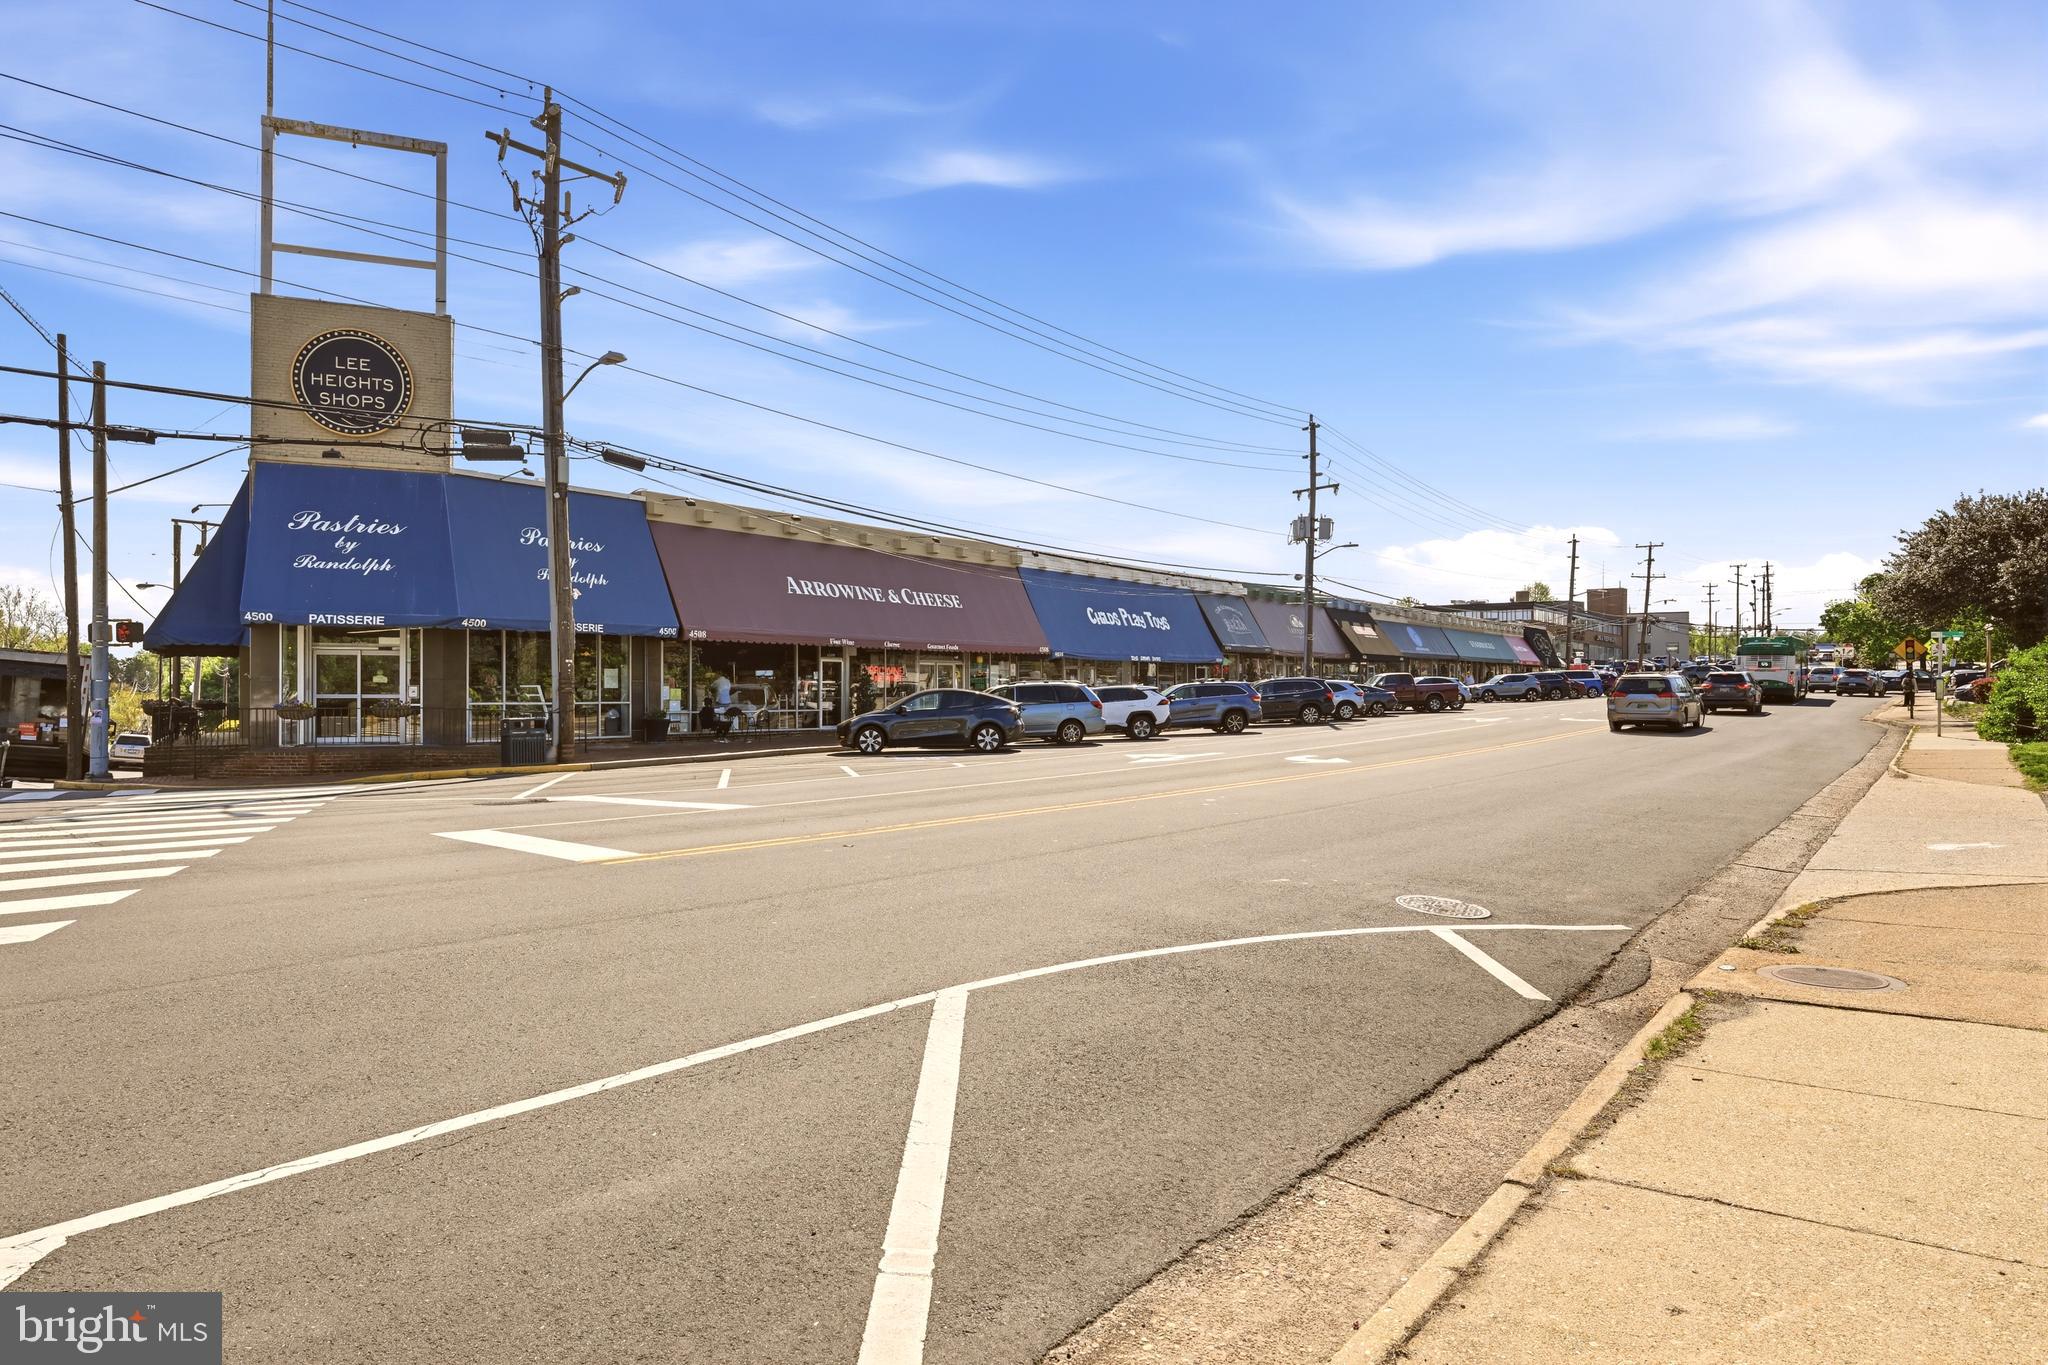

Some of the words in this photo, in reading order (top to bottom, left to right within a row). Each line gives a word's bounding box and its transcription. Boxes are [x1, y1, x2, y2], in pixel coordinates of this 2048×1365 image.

[335, 356, 371, 371] LEE
[311, 373, 394, 392] HEIGHTS
[319, 392, 386, 410] SHOPS
[288, 510, 408, 535] Pastries
[334, 536, 361, 554] by
[520, 527, 605, 552] Paries
[293, 554, 396, 576] Randolph
[537, 568, 608, 589] Rdolph
[787, 576, 886, 603] ARROWINE
[888, 589, 901, 604] &
[901, 588, 963, 609] CHEESE
[244, 611, 273, 621] 4500
[308, 613, 385, 625] PATISSERIE
[462, 618, 487, 628] 4500
[659, 627, 677, 636] 4500
[689, 629, 707, 639] 4508
